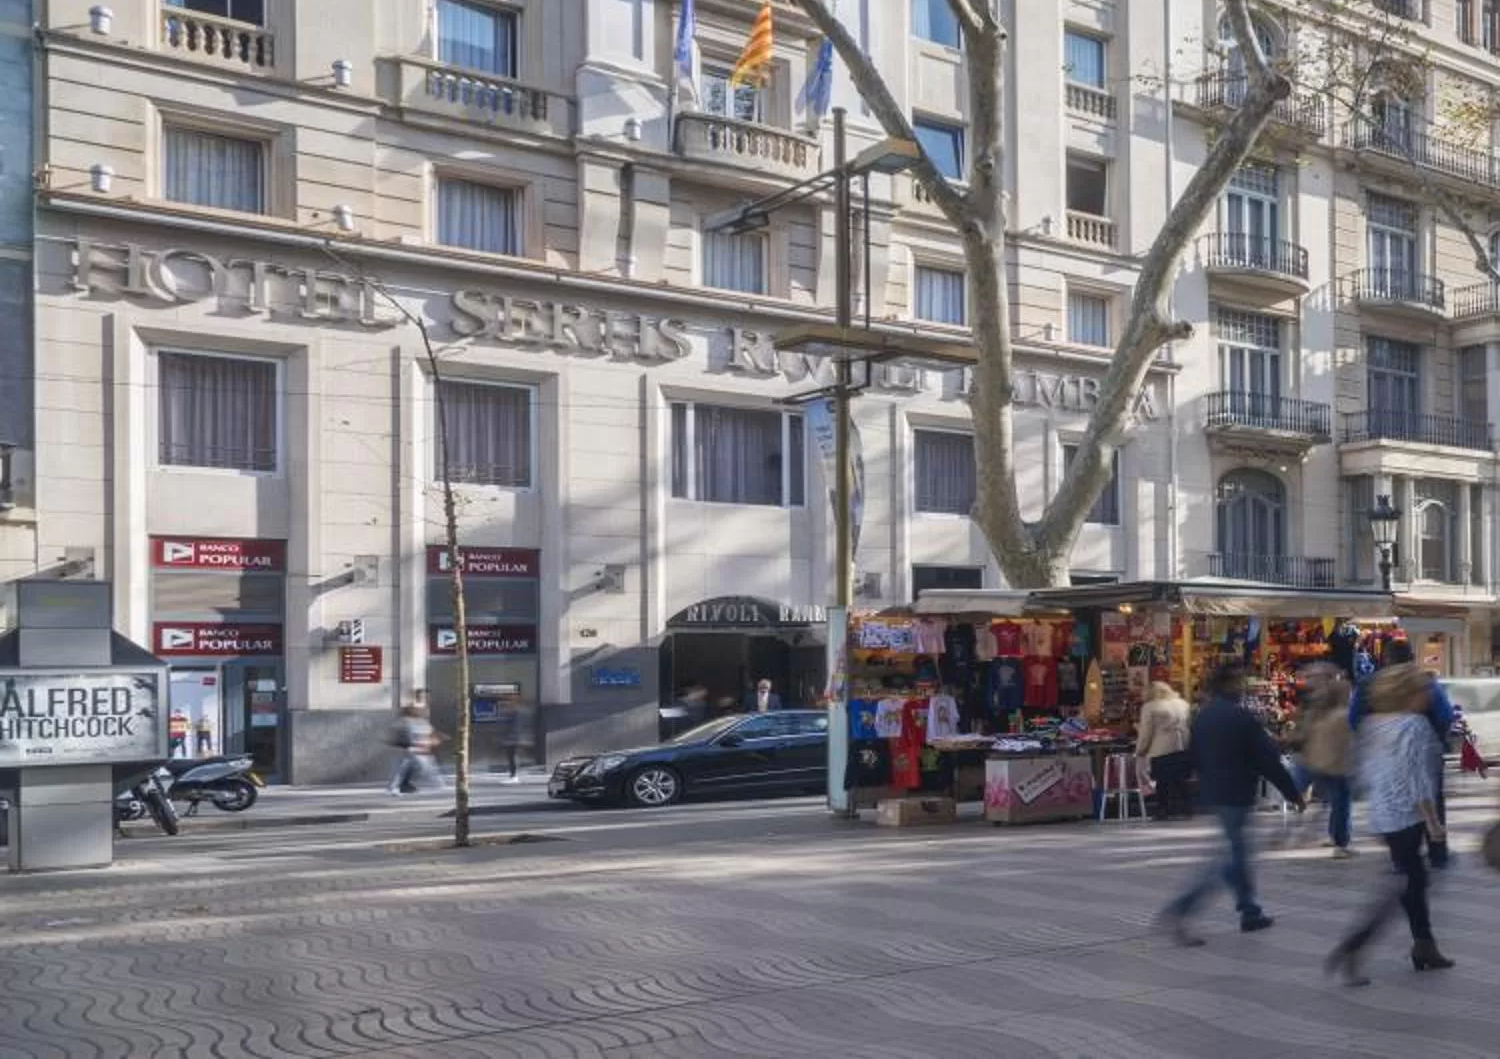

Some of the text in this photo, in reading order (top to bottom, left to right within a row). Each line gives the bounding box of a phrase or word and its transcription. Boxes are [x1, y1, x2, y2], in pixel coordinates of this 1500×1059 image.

[72, 241, 407, 326] HOTEL
[451, 290, 692, 360] SERHS
[199, 543, 240, 552] BANCO
[199, 554, 272, 566] POPULAR
[468, 562, 528, 573] POPULAR
[687, 604, 827, 622] RIVOLI RAMB
[199, 628, 240, 637] BANCO
[199, 640, 273, 650] POPULAR
[467, 640, 528, 650] POPULAR
[0, 686, 132, 718] ALFRED
[0, 716, 134, 740] HITCHCOCK
